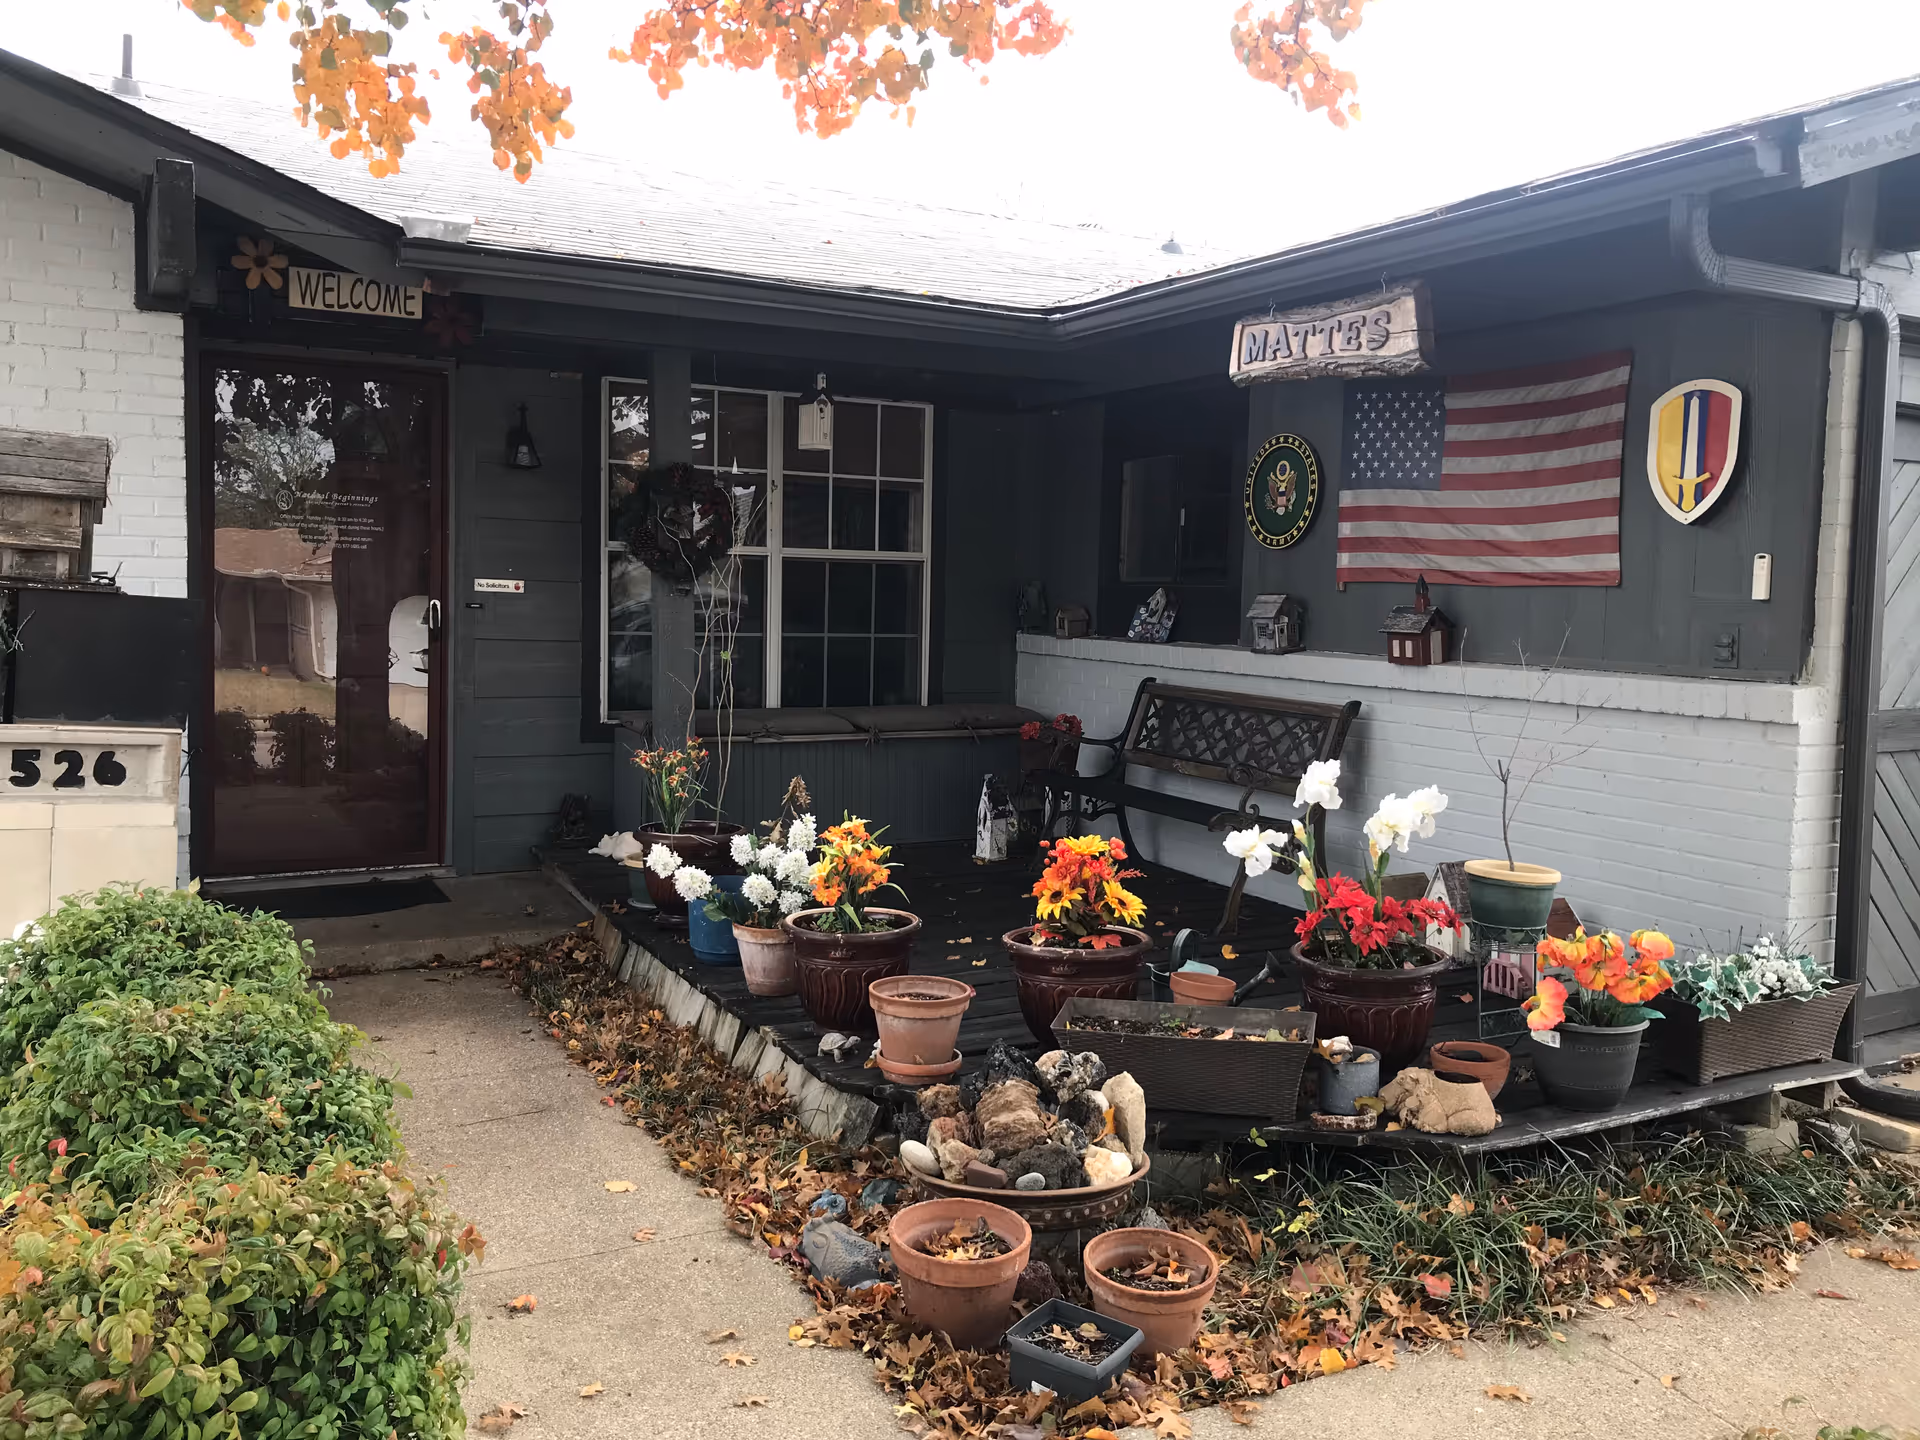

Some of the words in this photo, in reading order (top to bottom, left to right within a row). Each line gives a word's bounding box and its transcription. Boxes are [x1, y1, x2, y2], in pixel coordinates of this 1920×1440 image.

[296, 270, 416, 317] WELCOME
[1242, 309, 1392, 365] MATTES
[1245, 448, 1266, 494] UNITED
[1300, 444, 1316, 490] STATES
[331, 493, 379, 504] Beginnings
[1265, 536, 1292, 546] ARMY
[8, 749, 127, 789] 526
